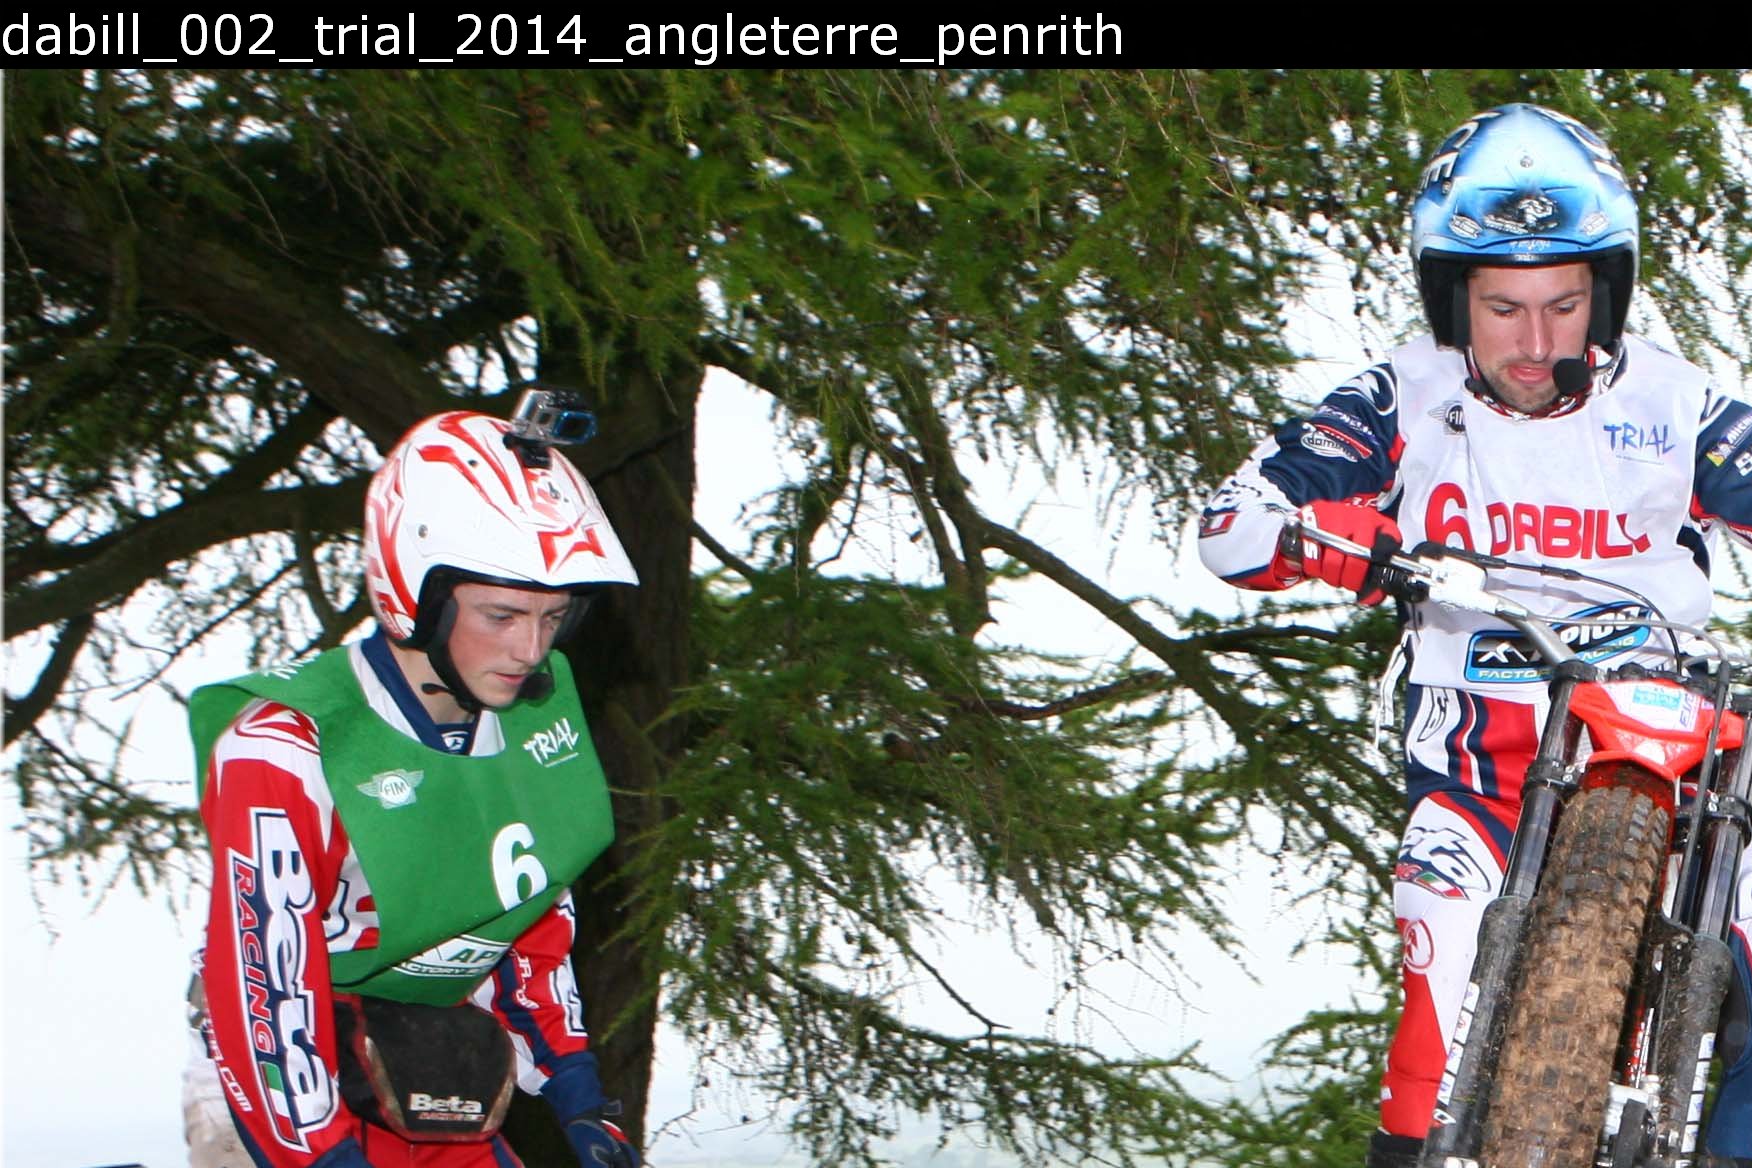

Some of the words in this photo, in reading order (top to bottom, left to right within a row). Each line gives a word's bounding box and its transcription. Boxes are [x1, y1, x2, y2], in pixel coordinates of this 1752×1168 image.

[1603, 422, 1677, 458] TRIAL
[1425, 482, 1475, 554] 6
[1486, 502, 1651, 560] DABILL
[523, 717, 579, 766] TRIAL
[383, 780, 409, 797] FIM
[492, 822, 549, 911] 6
[233, 857, 276, 1056] RACING
[253, 810, 339, 1132] Beta
[409, 1092, 482, 1114] Beta
